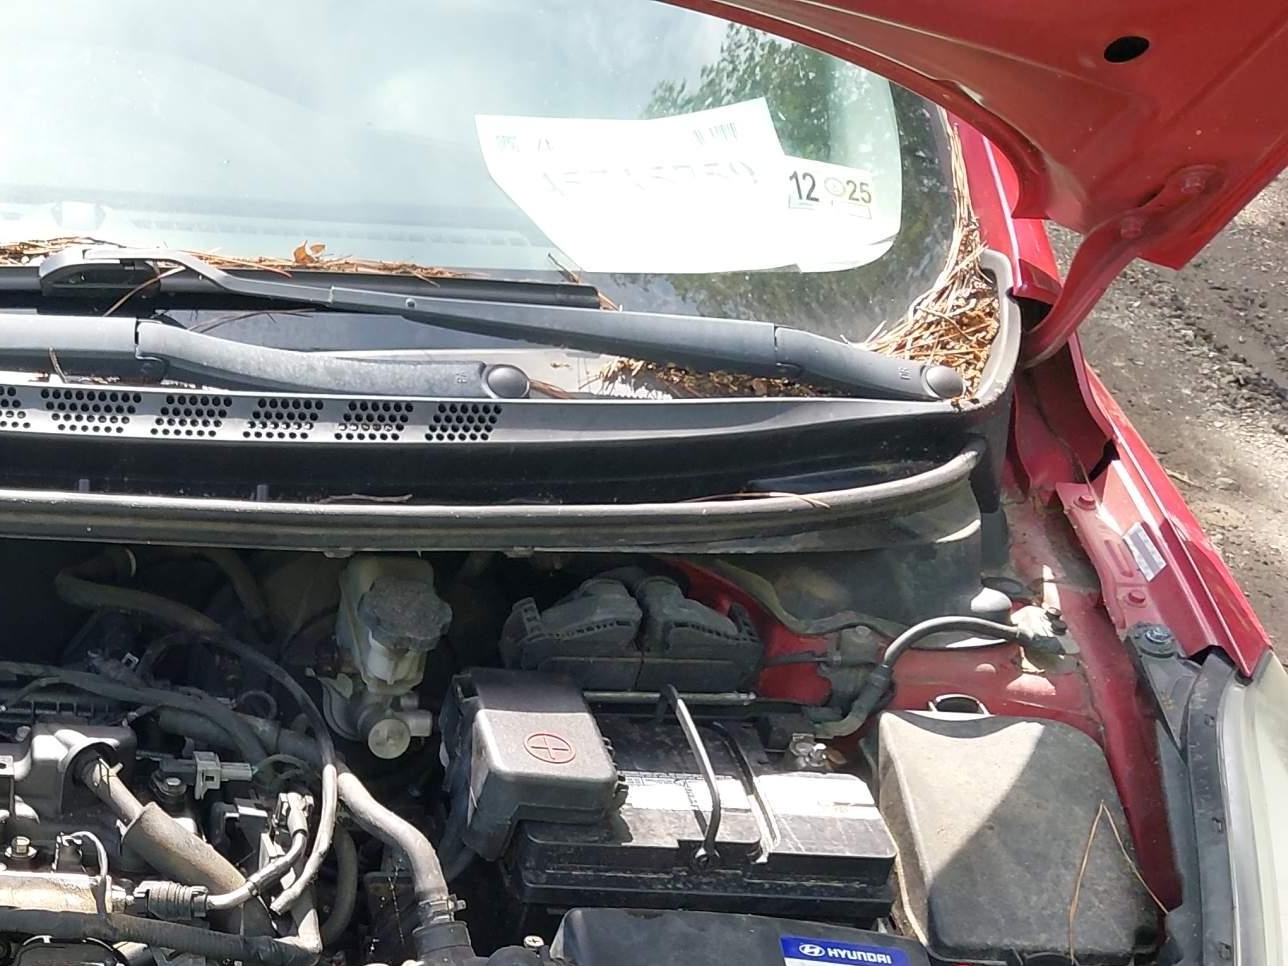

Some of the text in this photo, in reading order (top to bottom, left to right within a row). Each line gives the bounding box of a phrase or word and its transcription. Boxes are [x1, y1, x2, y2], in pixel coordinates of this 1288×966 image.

[788, 170, 820, 202] 12
[845, 179, 872, 204] 25
[826, 947, 892, 964] HYUNDAI
